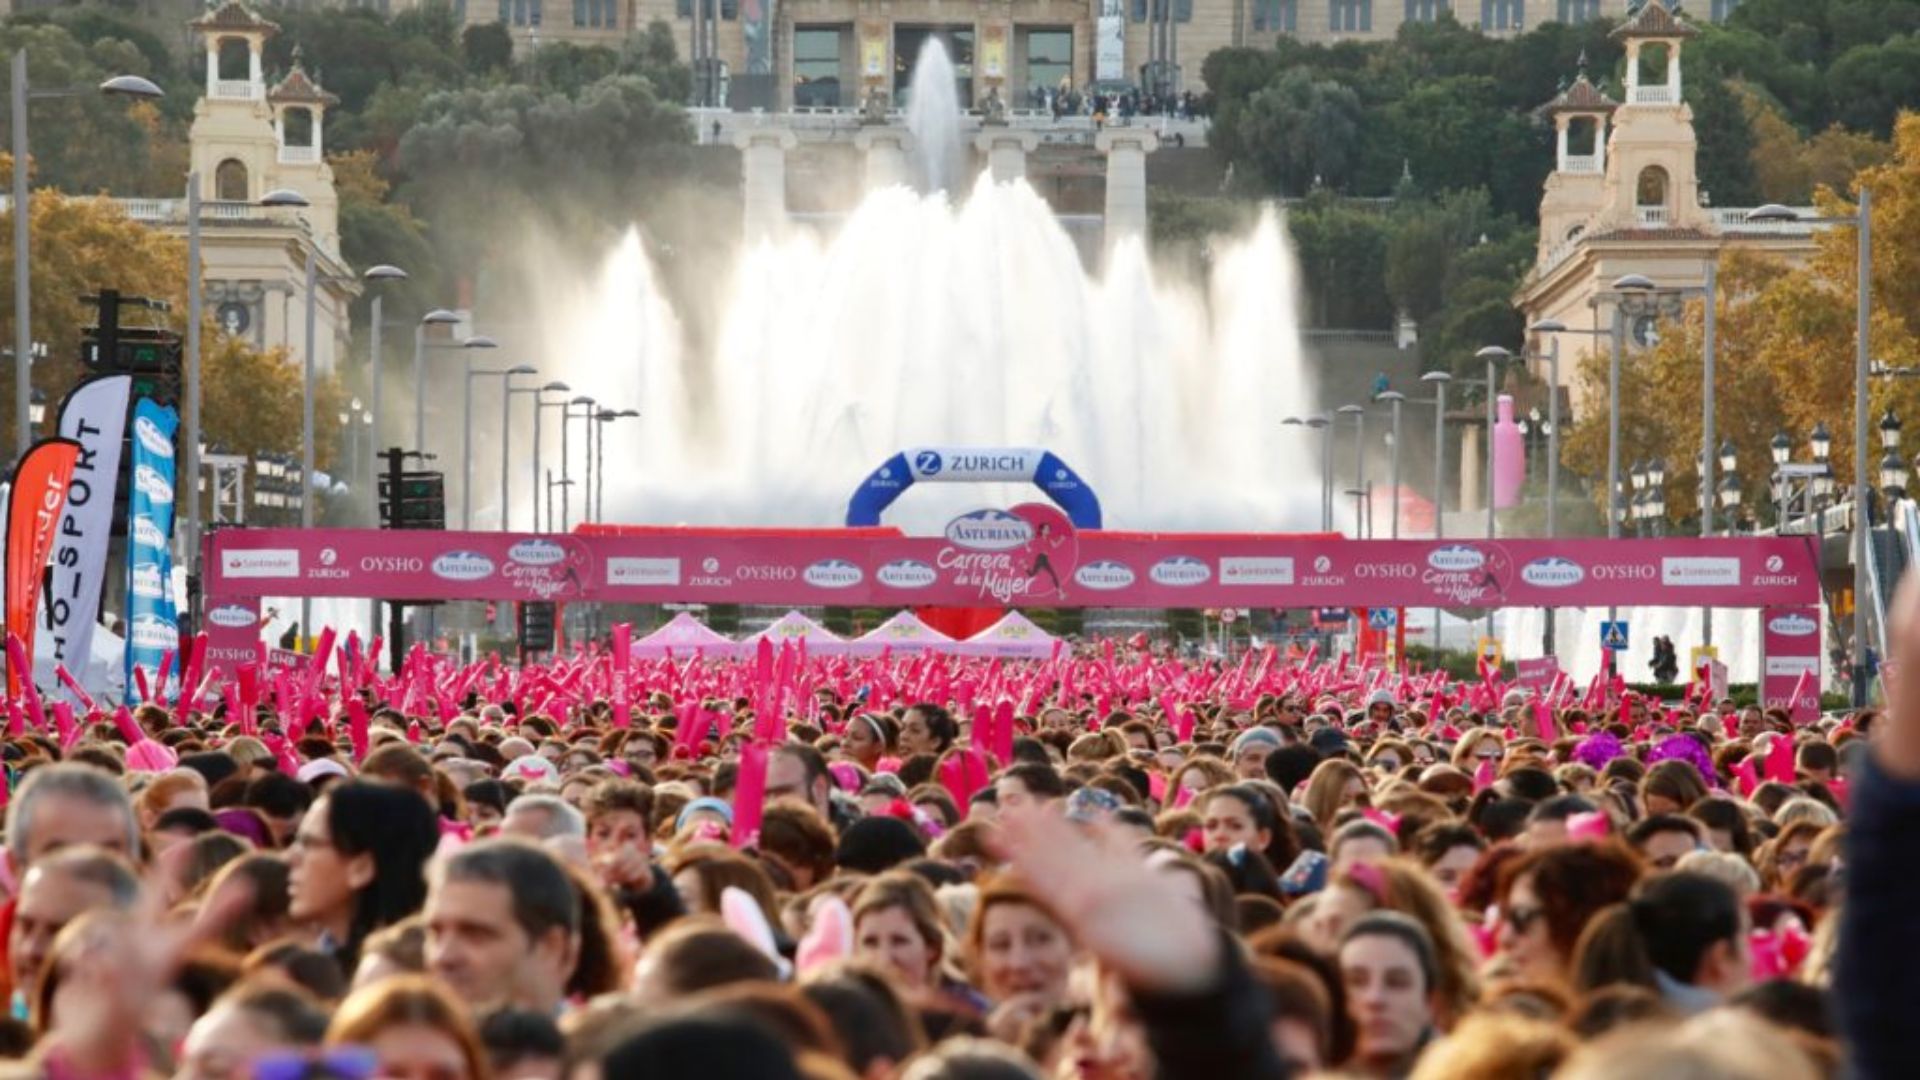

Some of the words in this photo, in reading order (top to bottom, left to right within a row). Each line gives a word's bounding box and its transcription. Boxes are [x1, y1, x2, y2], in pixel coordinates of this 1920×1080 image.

[951, 456, 1024, 472] ZURICH
[954, 524, 1026, 540] ASTURIANA
[361, 556, 423, 572] OYSHO
[937, 546, 1011, 569] Carrera
[308, 568, 350, 578] ZURICH
[736, 565, 797, 581] OYSHO
[1355, 563, 1417, 579] OYSHO
[1592, 564, 1656, 580] OYSHO
[979, 568, 1035, 603] Mujer
[1302, 576, 1345, 586] ZURICH
[1752, 575, 1798, 586] ZURICH
